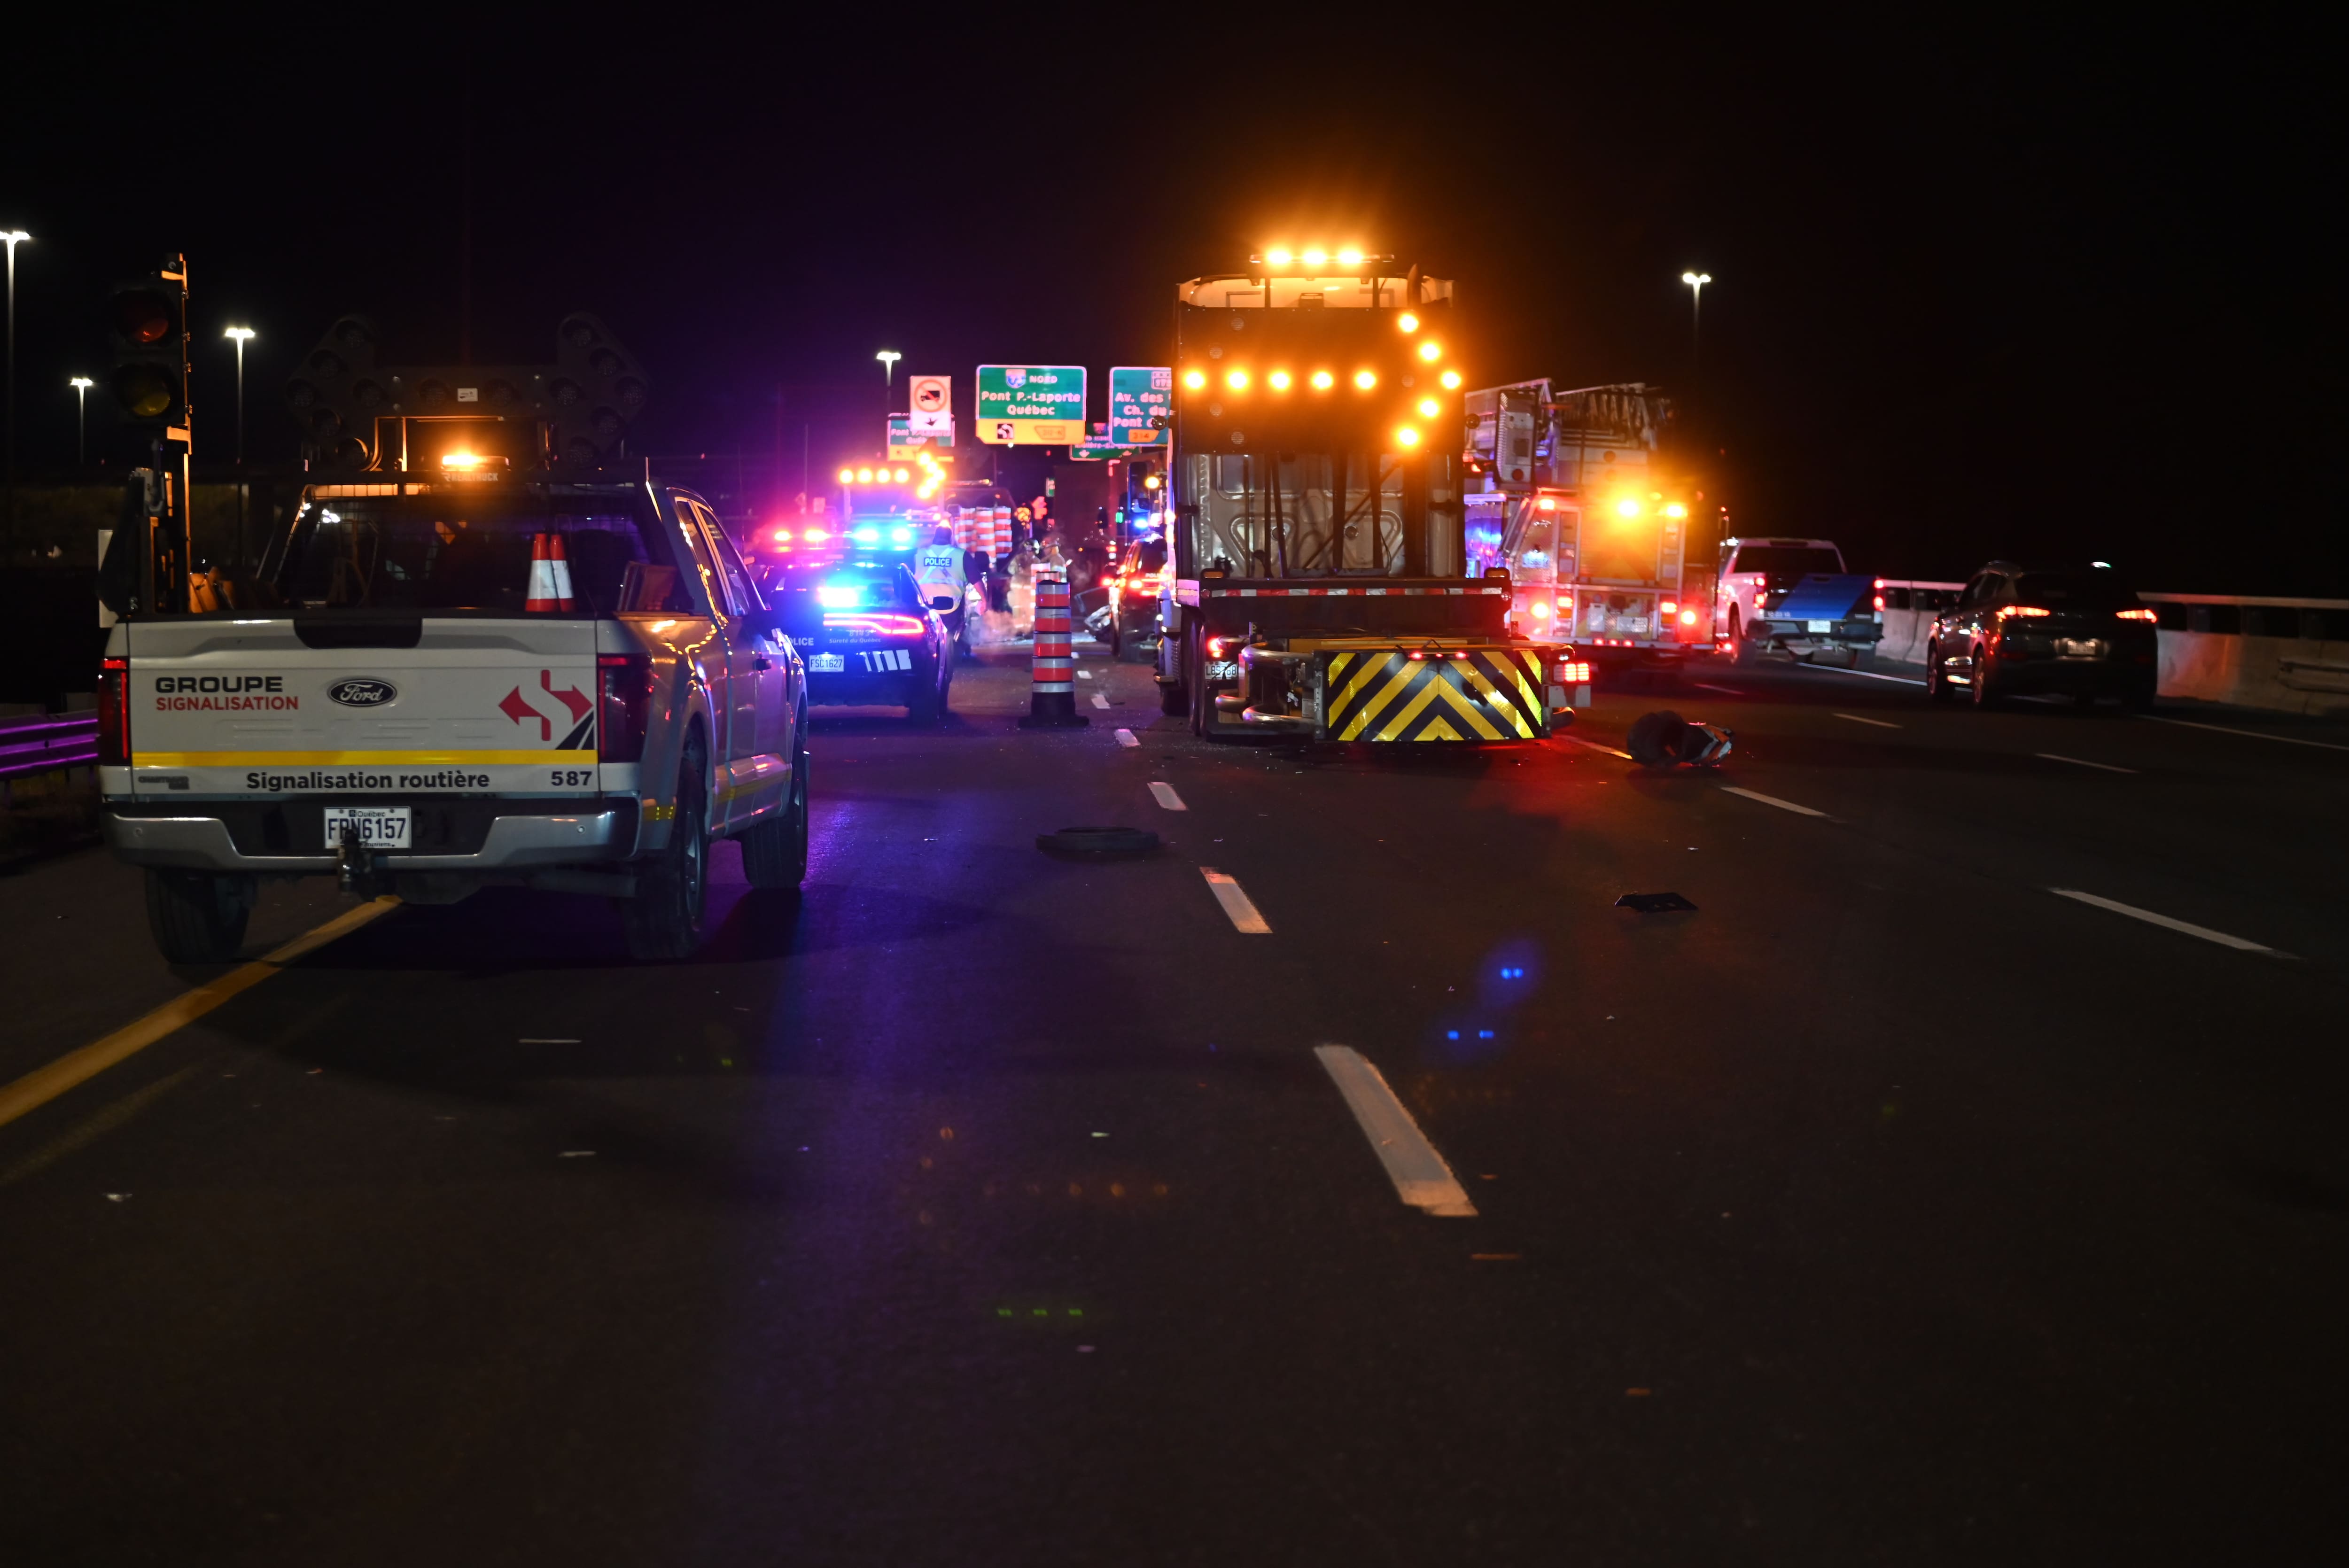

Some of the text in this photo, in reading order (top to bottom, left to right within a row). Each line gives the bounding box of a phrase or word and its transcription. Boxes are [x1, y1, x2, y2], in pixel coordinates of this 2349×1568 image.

[981, 391, 1081, 404] Pont P.-Laporte
[1115, 392, 1164, 403] Av. des
[1007, 404, 1055, 415] Québec
[1123, 405, 1167, 416] Ch. du
[1113, 417, 1143, 427] Pont
[925, 558, 950, 566] POLICE
[810, 659, 843, 668] FSC1627
[156, 676, 283, 693] GROUPE
[339, 683, 383, 701] Ford
[156, 696, 299, 711] SIGNALISATION
[247, 772, 490, 792] Signalisation routière
[551, 771, 593, 786] 587
